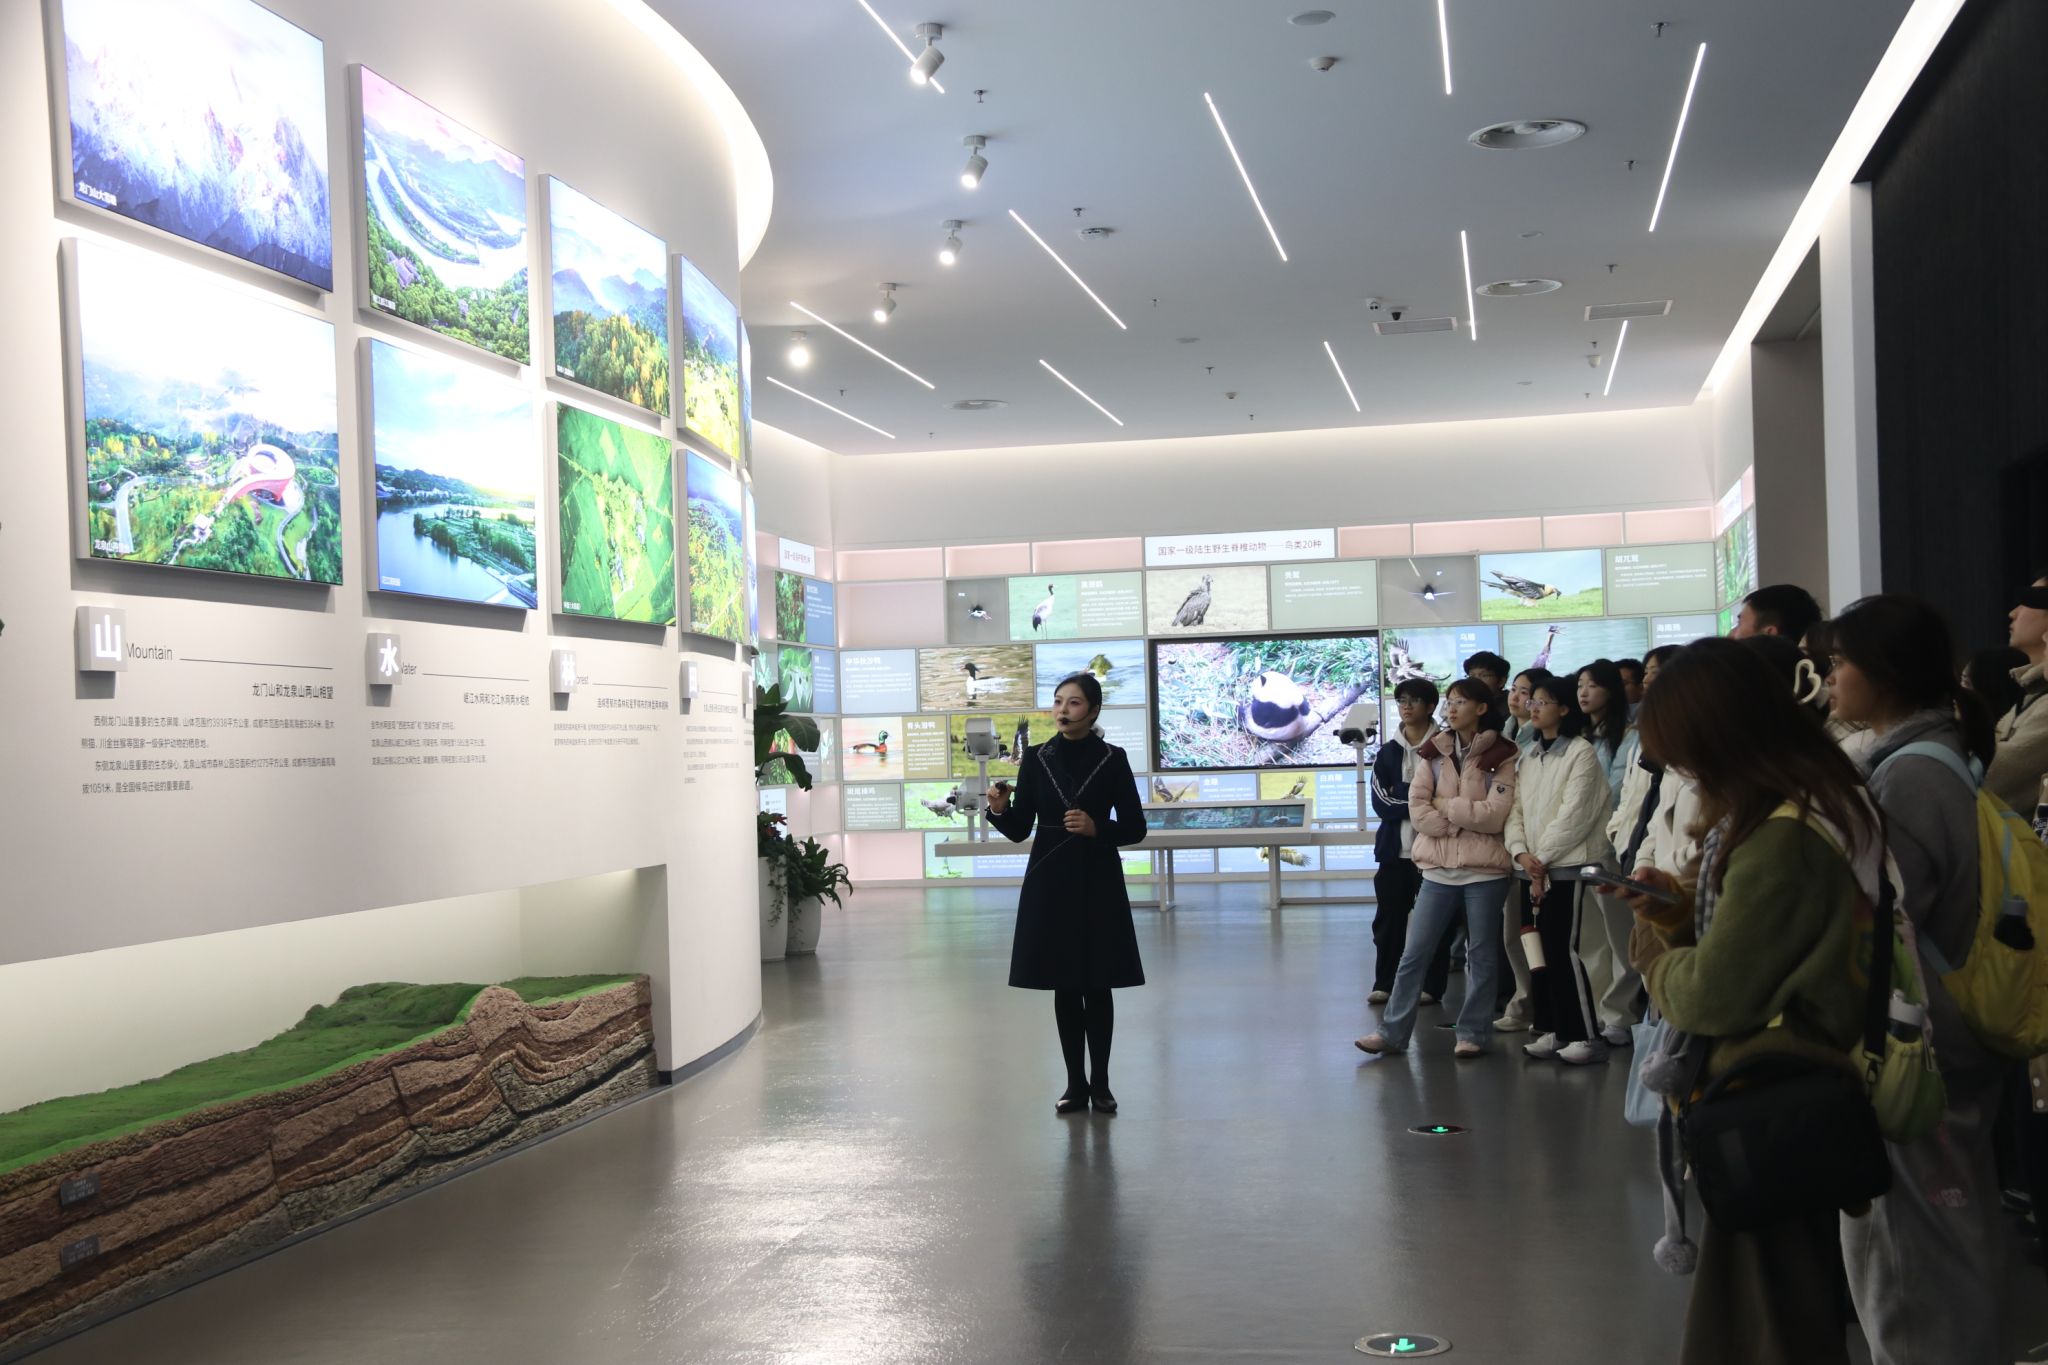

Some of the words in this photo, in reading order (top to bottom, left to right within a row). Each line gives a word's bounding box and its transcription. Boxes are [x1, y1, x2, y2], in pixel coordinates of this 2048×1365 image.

[95, 614, 122, 662] 山
[379, 638, 400, 677] 水
[252, 682, 334, 700] 龙门山和龙泉山两山相望
